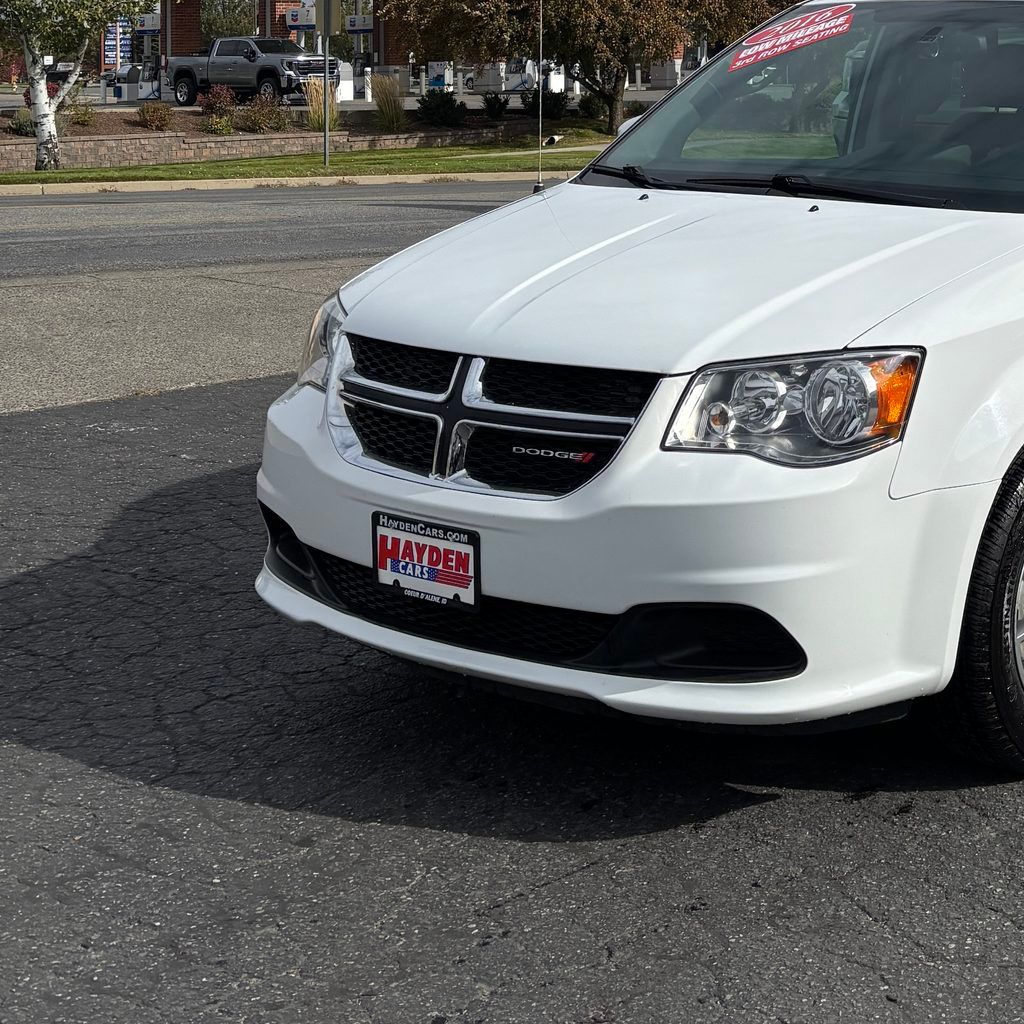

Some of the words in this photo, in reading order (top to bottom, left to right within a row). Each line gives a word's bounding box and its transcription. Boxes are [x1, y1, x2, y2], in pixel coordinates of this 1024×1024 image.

[739, 39, 777, 58] LOW
[775, 15, 850, 45] MILEAGE
[793, 23, 850, 47] SEATING
[512, 446, 583, 461] DODGE
[377, 533, 470, 575] HAYDEN
[399, 561, 429, 579] CARS
